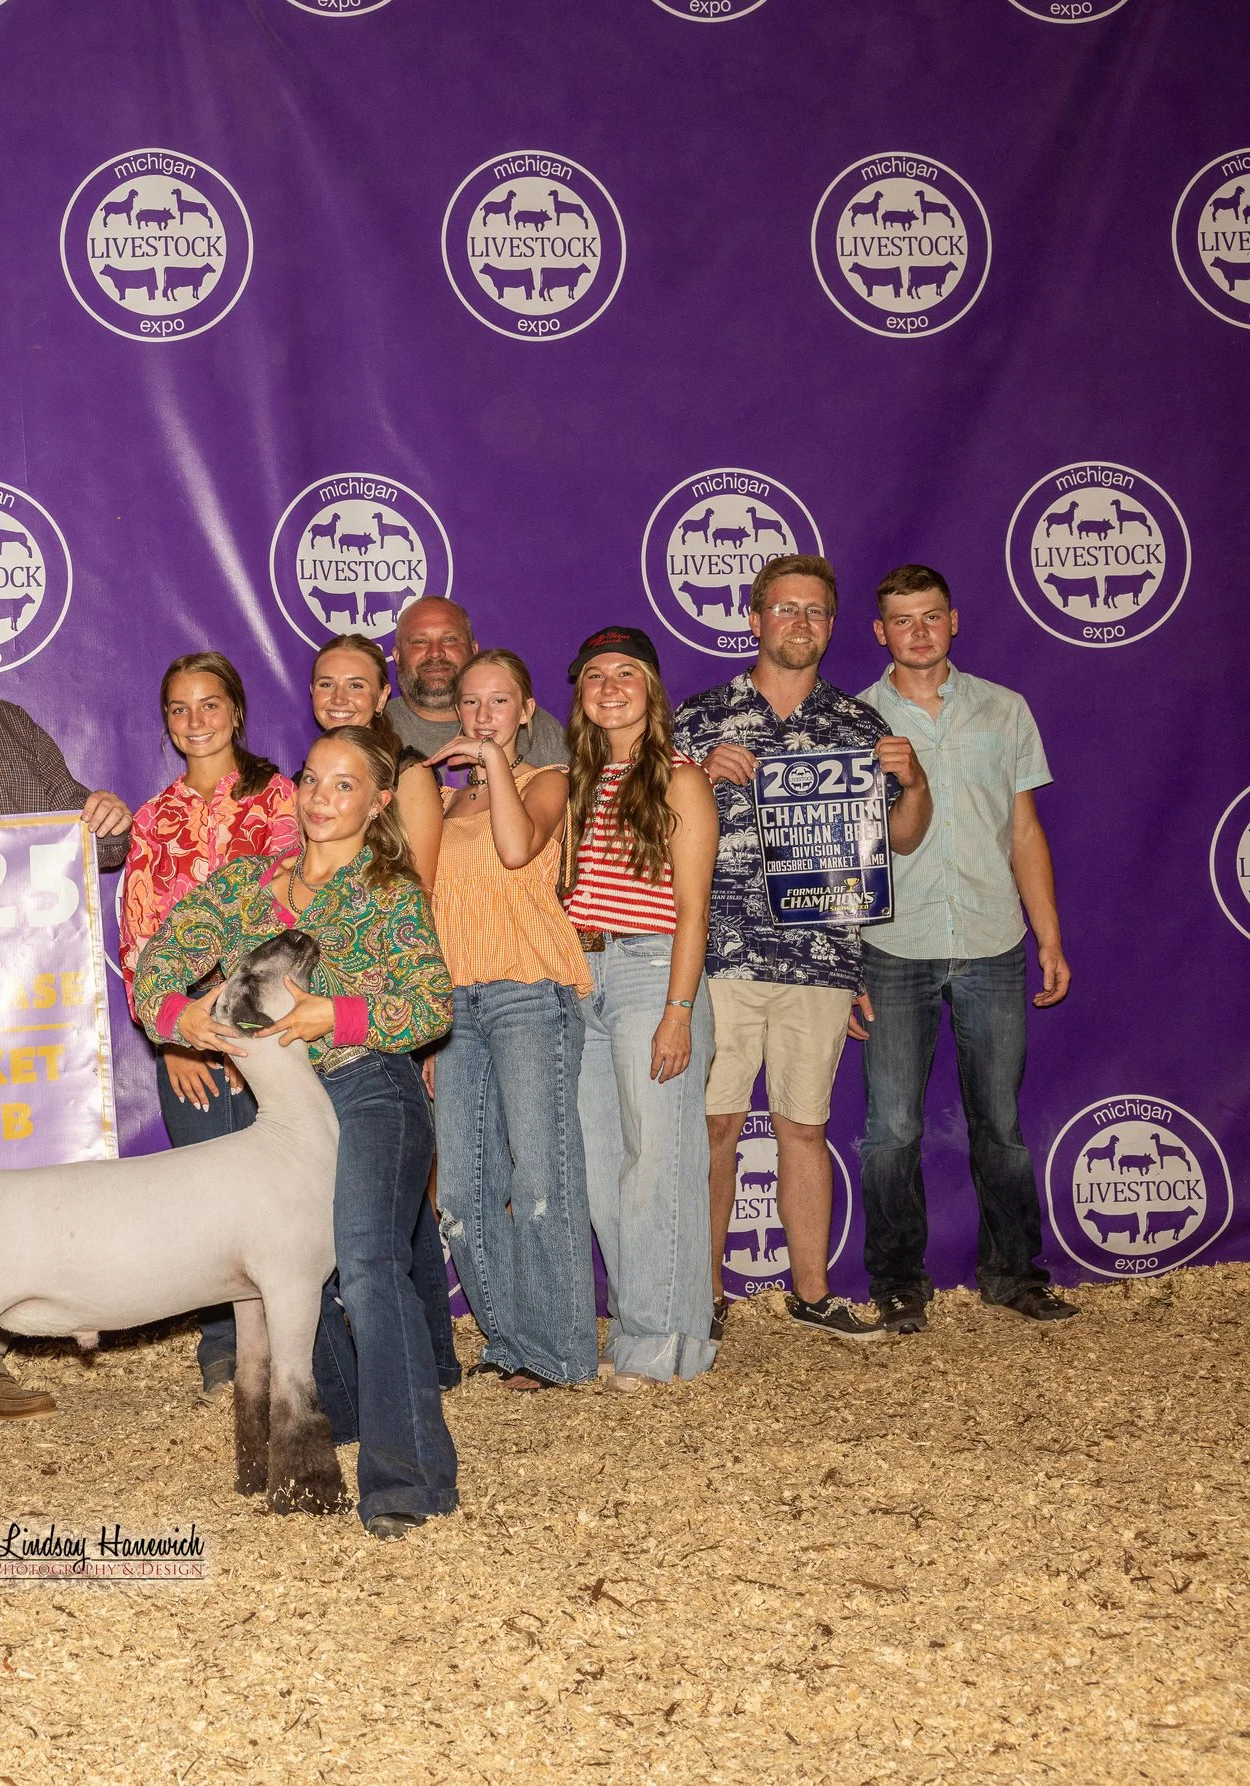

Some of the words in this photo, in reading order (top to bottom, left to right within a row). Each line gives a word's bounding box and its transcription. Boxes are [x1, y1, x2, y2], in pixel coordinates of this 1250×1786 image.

[690, 0, 731, 17] expo
[1051, 2, 1092, 18] expo
[115, 154, 195, 178] michigan
[494, 156, 572, 179] michigan
[862, 157, 937, 180] michigan
[90, 236, 223, 258] LIVESTOCK
[470, 237, 598, 257] LIVESTOCK
[839, 236, 965, 256] LIVESTOCK
[140, 319, 184, 336] expo
[518, 319, 560, 336] expo
[887, 316, 928, 332] expo
[320, 478, 397, 501] michigan
[692, 474, 769, 497] michigan
[1056, 467, 1134, 490] michigan
[669, 553, 795, 576] LIVESTO
[1034, 544, 1162, 567] LIVESTOCK
[299, 559, 423, 581] LIVESTOCK
[718, 636, 758, 652] expo
[1083, 626, 1125, 642] expo
[761, 800, 881, 827] CHAMPION
[763, 824, 831, 847] MICHIGAN
[792, 844, 841, 858] DIVISION
[767, 859, 813, 872] CROSSBRED
[820, 856, 854, 869] MARKET
[780, 891, 875, 913] CHAMPIONS
[787, 886, 831, 896] FORMULA
[1093, 1100, 1172, 1125] michigan
[1076, 1180, 1204, 1203] LIVESTOCK
[1115, 1258, 1158, 1273] expo
